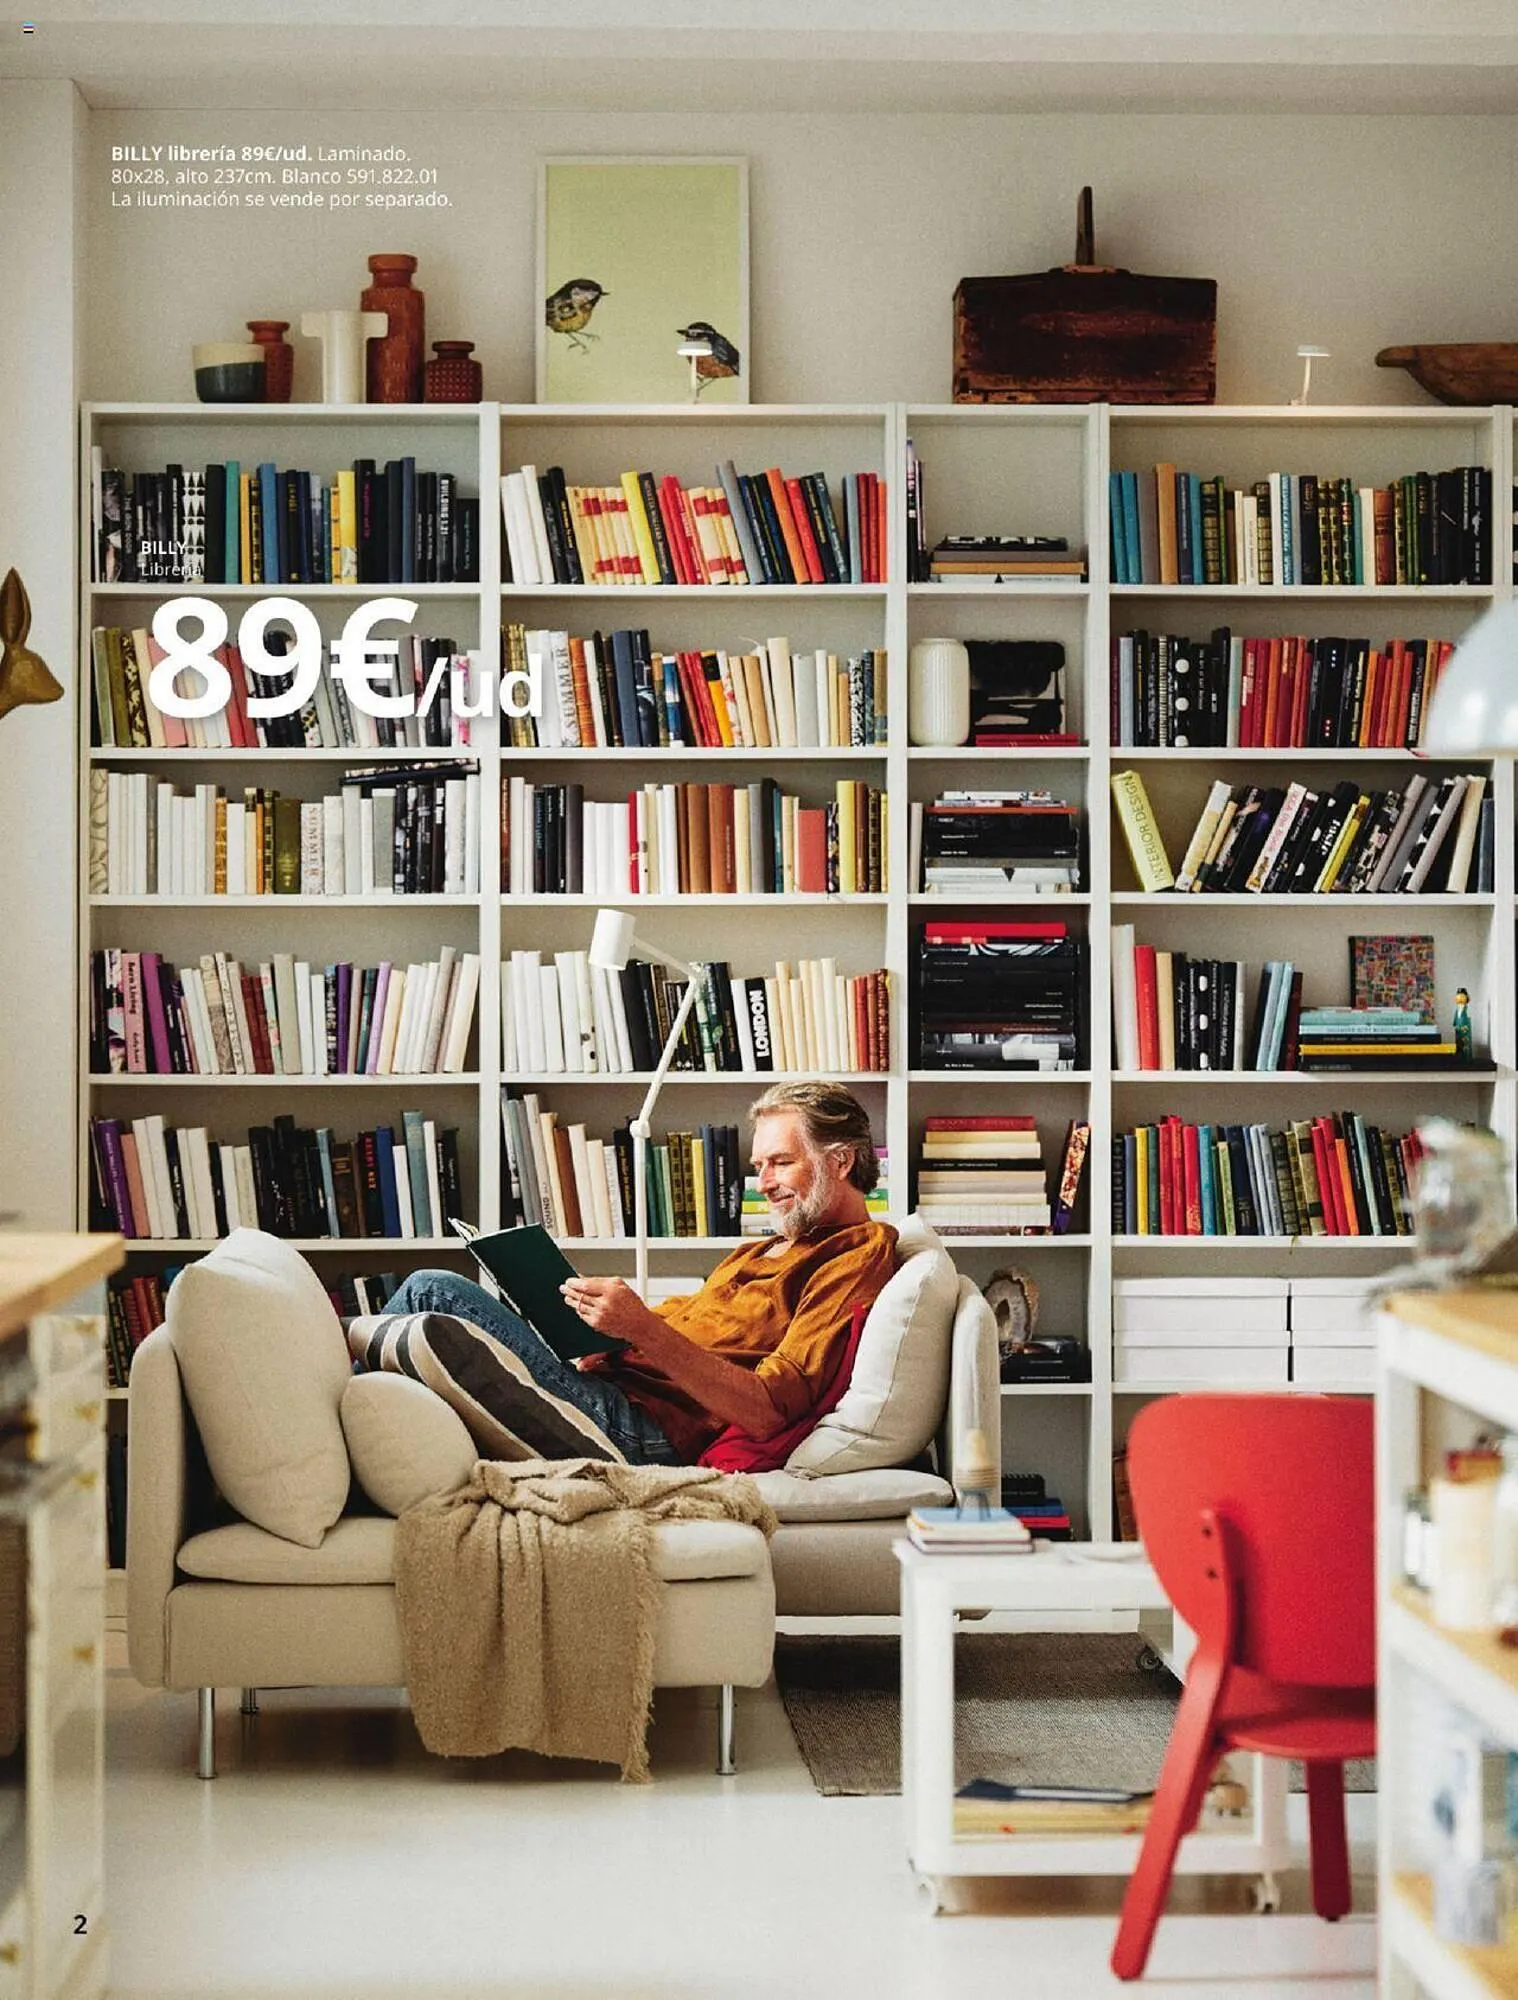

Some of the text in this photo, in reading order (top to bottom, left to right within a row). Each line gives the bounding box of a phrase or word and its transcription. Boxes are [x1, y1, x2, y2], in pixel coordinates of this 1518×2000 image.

[555, 647, 577, 729] SUMMER
[1123, 775, 1165, 882] INTERIOR DESIGN
[748, 989, 770, 1058] LONDON
[542, 1196, 553, 1229] SOUND
